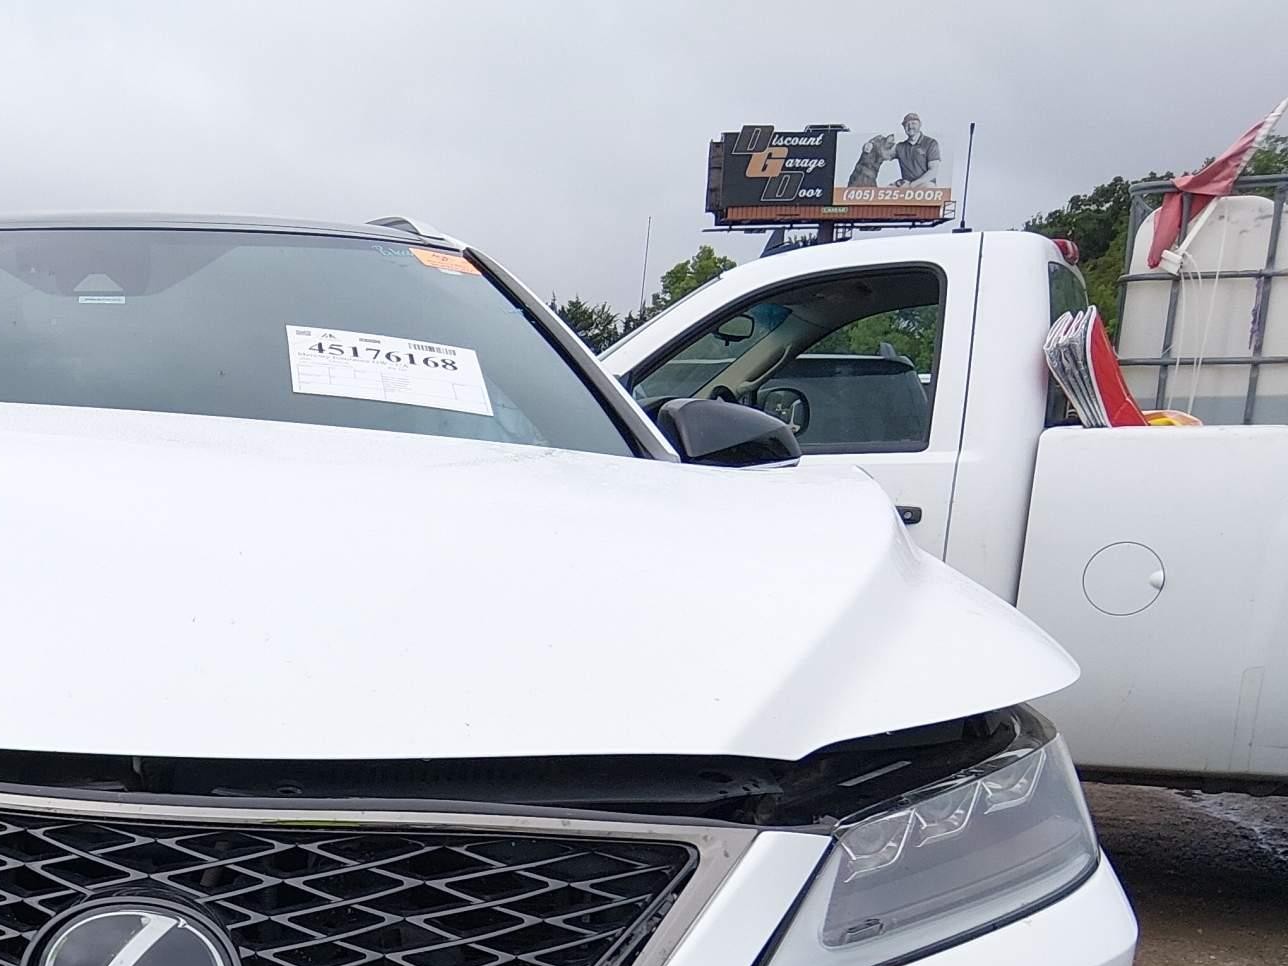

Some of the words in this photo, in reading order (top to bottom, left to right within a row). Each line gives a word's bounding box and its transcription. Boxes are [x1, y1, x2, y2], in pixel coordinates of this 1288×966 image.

[732, 125, 824, 154] Discount
[746, 147, 826, 178] Garage
[760, 171, 823, 201] Door
[842, 189, 875, 201] (405)
[877, 189, 943, 201] 525-DOOR
[308, 341, 459, 371] 45176168
